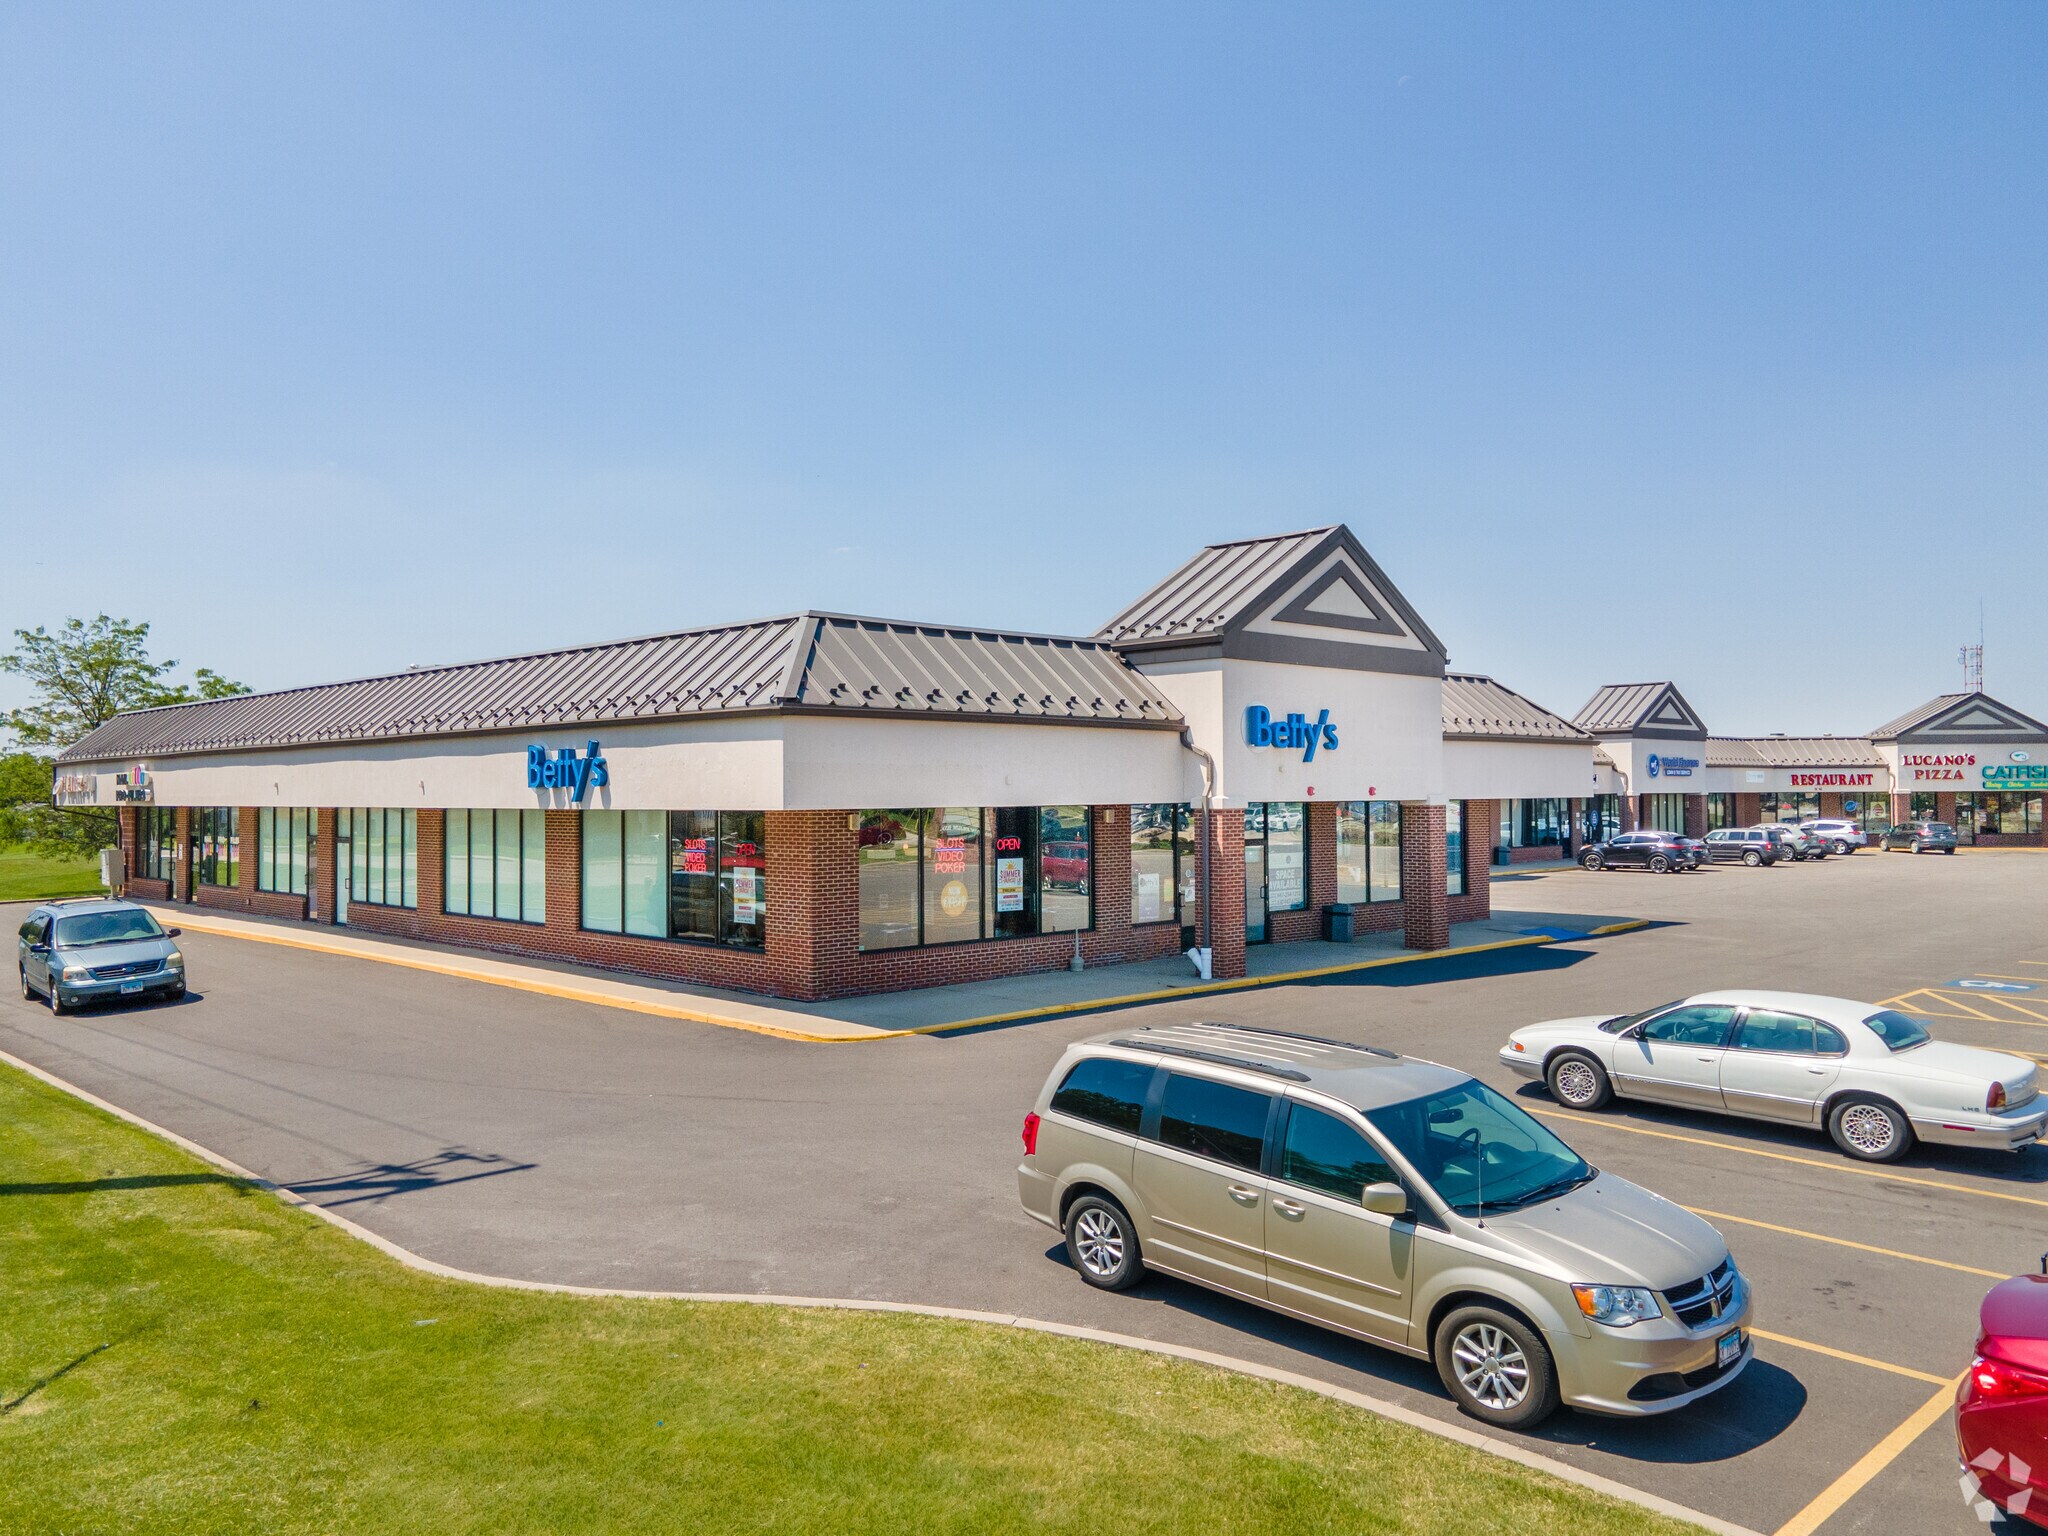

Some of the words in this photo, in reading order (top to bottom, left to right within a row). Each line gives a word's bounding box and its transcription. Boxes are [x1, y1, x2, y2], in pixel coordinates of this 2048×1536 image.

[1248, 705, 1338, 762] Betty's
[1902, 753, 1976, 766] LUCANO'S
[527, 739, 609, 802] Betty's
[1914, 769, 1965, 780] PIZZA
[1790, 774, 1874, 786] RESTAURANT
[684, 838, 707, 850] SLOTS
[735, 843, 756, 856] OPEN
[936, 838, 964, 849] SLOTS
[997, 838, 1020, 850] OPEN
[685, 852, 706, 863] VIDEO
[937, 851, 963, 861] VIDEO
[684, 862, 707, 873] POKER
[934, 862, 965, 874] POKER
[1000, 870, 1020, 878] SUMMER
[1275, 870, 1295, 879] SPACE
[1269, 878, 1302, 891] AVAILABLE
